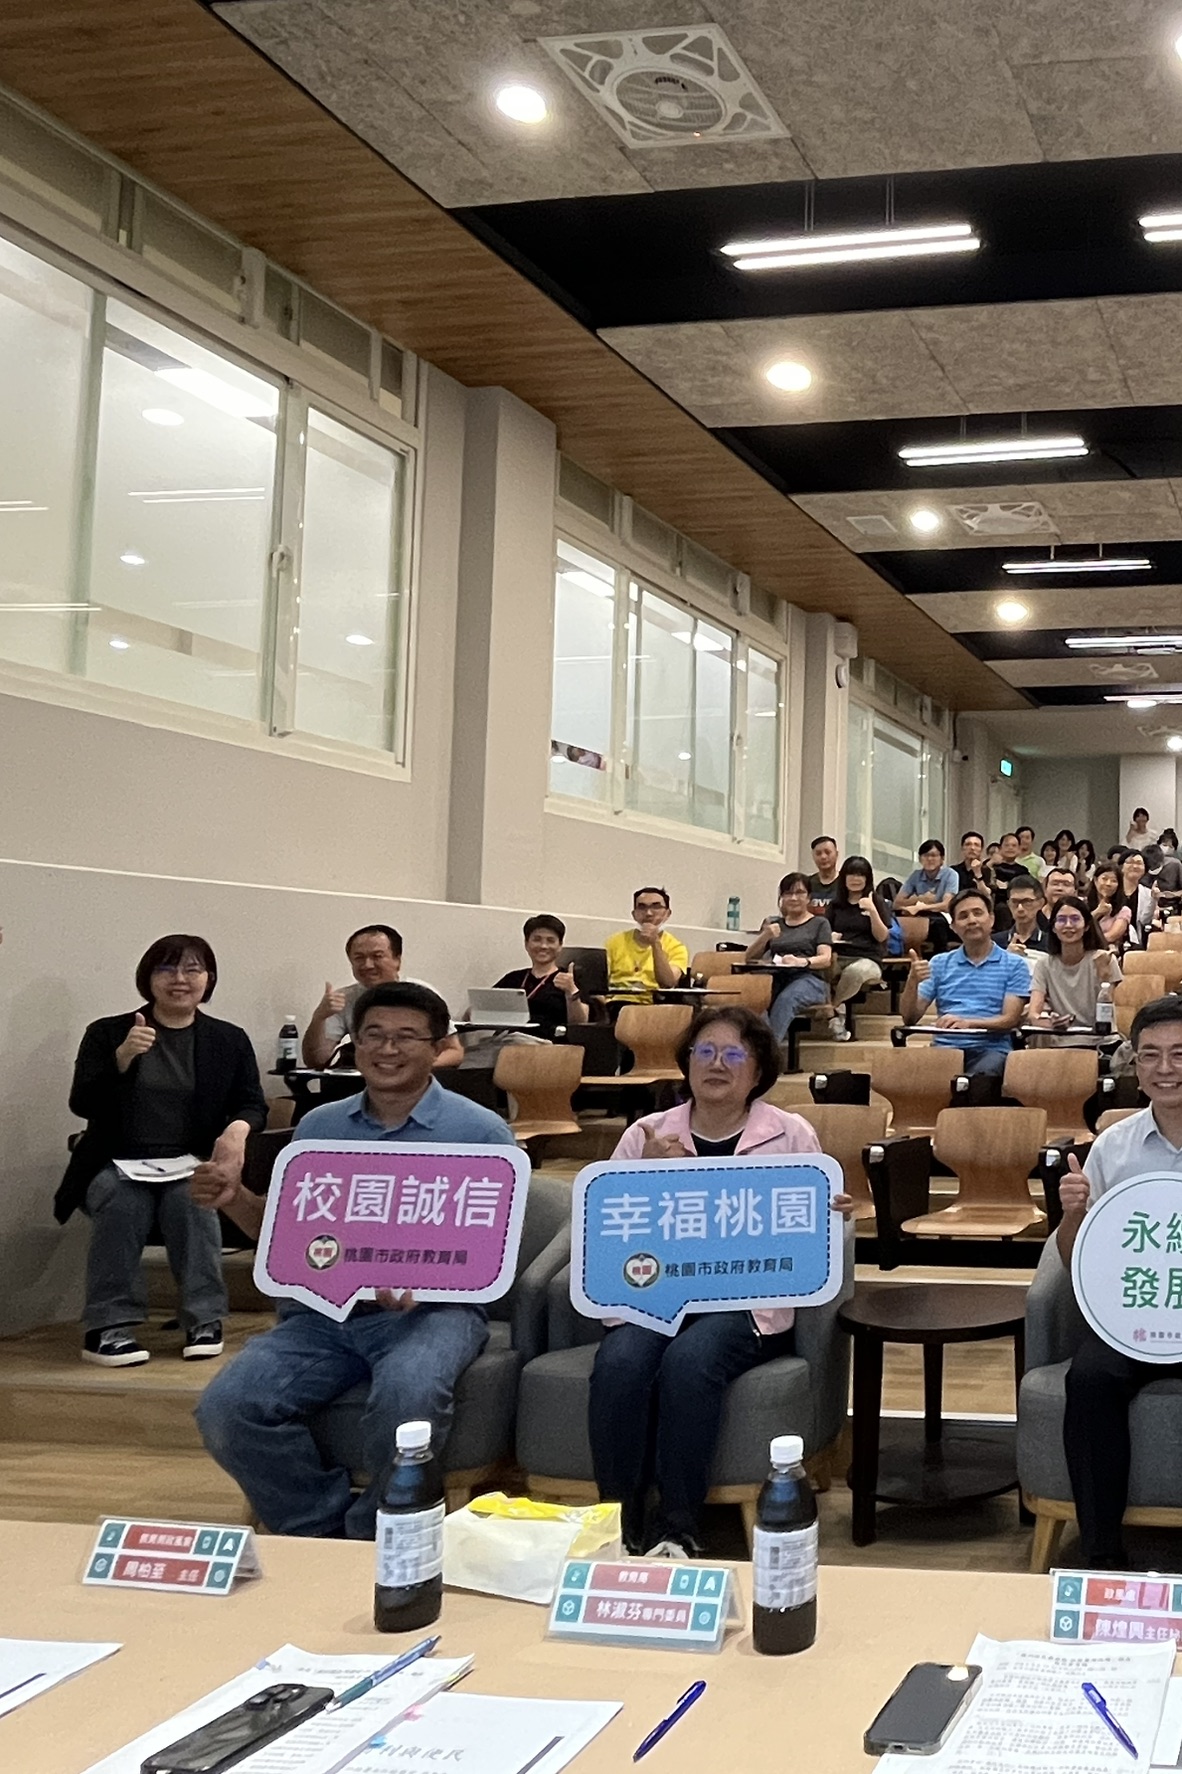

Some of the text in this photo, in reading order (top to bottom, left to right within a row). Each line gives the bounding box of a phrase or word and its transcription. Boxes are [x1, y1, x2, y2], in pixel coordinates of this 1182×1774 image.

[293, 1172, 504, 1228] 校園誠信
[599, 1185, 818, 1244] 幸福桃園
[344, 1247, 468, 1265] 桃園市政府教育局
[664, 1256, 793, 1278] 桃園市政府教育局
